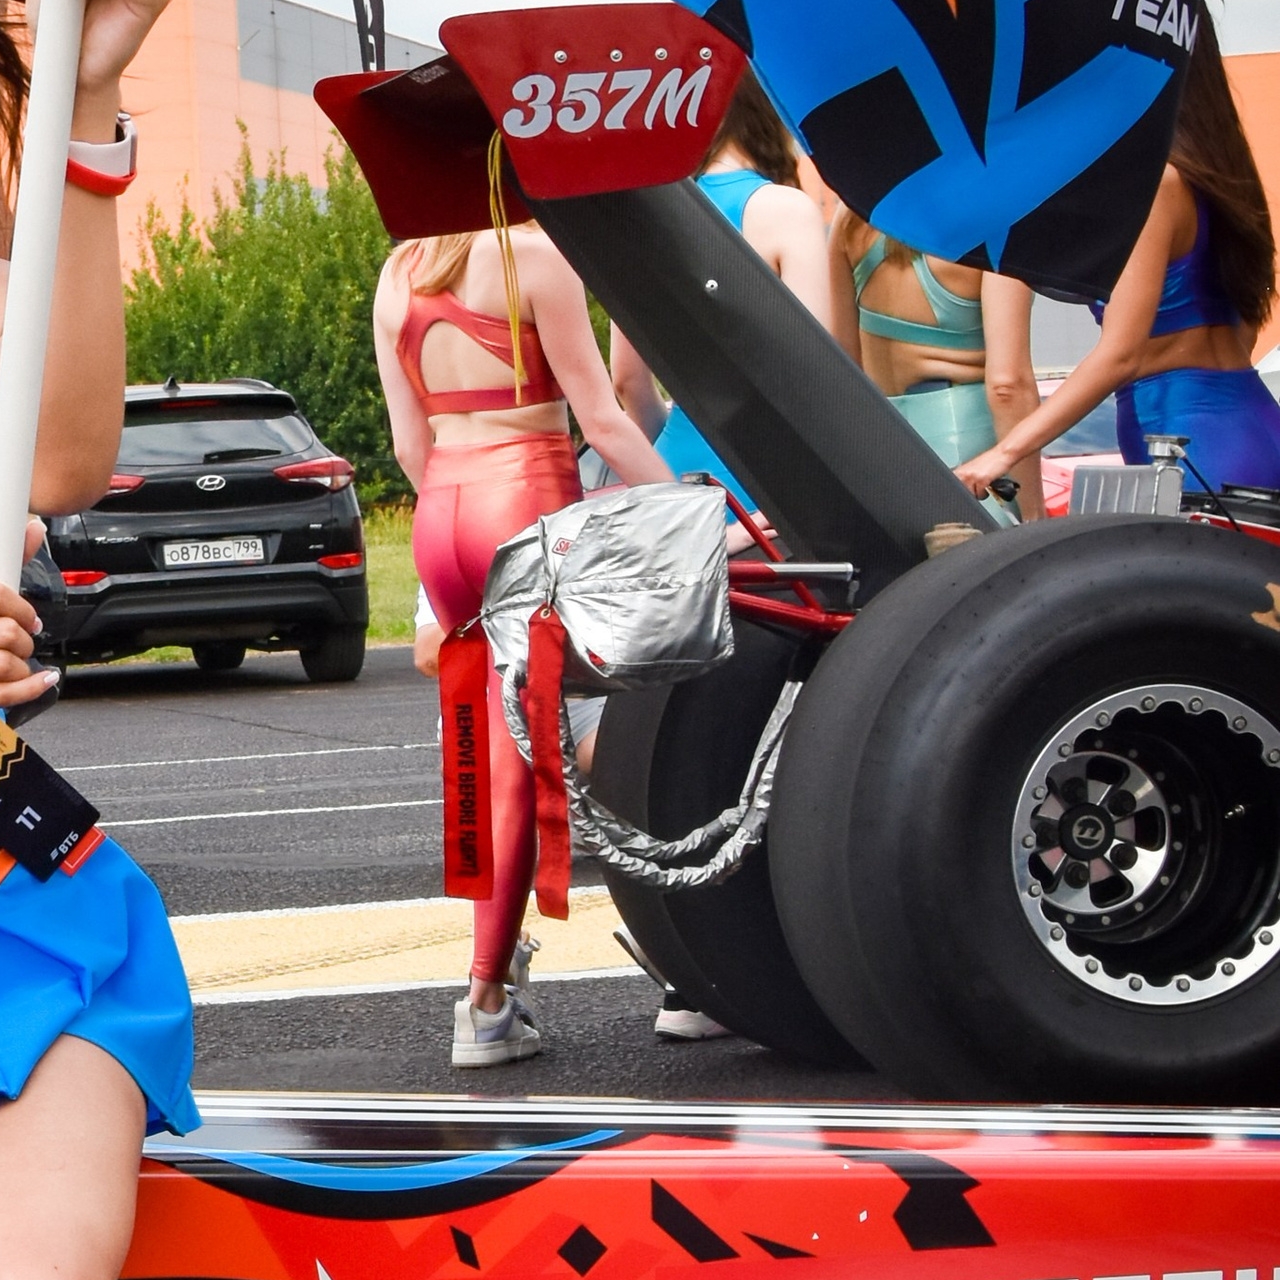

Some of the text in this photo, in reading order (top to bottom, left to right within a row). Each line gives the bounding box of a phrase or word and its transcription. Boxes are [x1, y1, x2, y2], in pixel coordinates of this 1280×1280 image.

[502, 64, 712, 139] 357M
[236, 541, 258, 554] 799
[456, 704, 477, 767] REMOVE
[15, 805, 42, 831] 11
[458, 773, 477, 826] BEFORE
[58, 831, 80, 855] ВТБ
